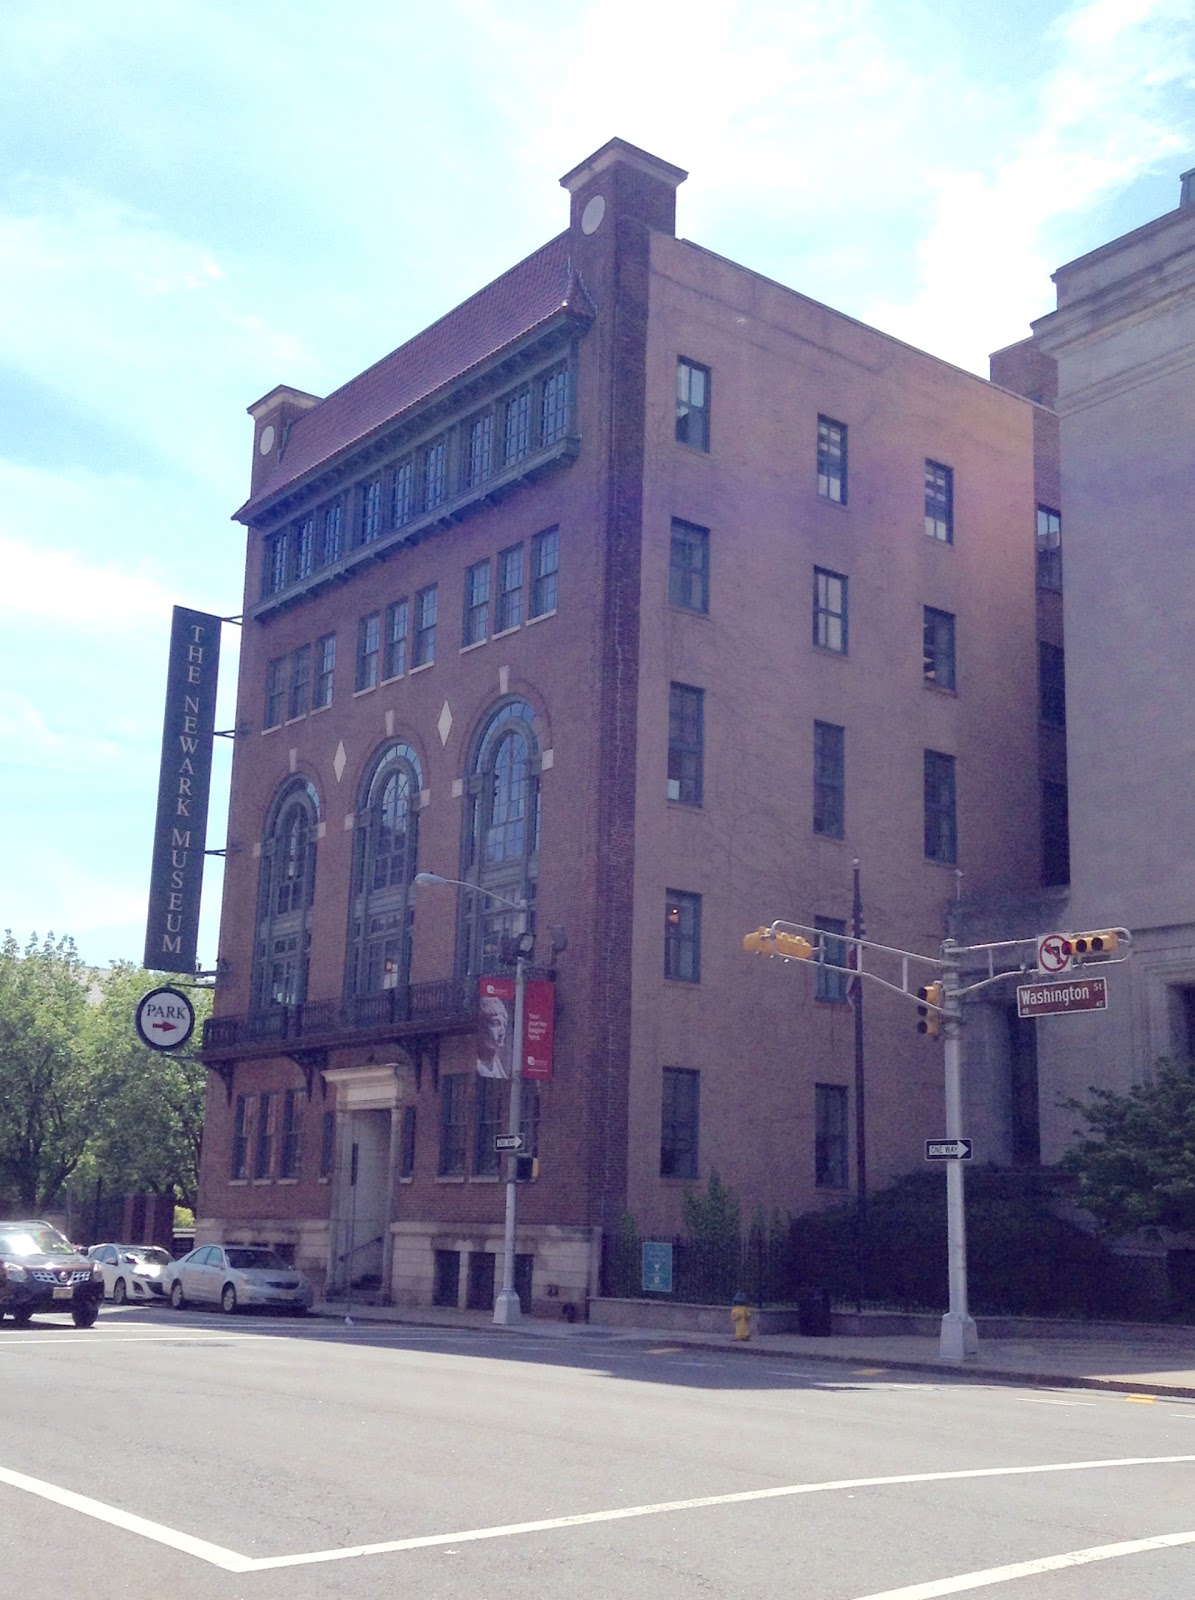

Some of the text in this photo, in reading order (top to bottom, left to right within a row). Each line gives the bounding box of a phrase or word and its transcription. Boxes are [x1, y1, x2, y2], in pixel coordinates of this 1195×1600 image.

[162, 625, 204, 954] THE NEWARK MUSEUM
[1021, 983, 1102, 1006] Washington St
[147, 1004, 186, 1020] PARK
[930, 1145, 958, 1154] ONE WAY
